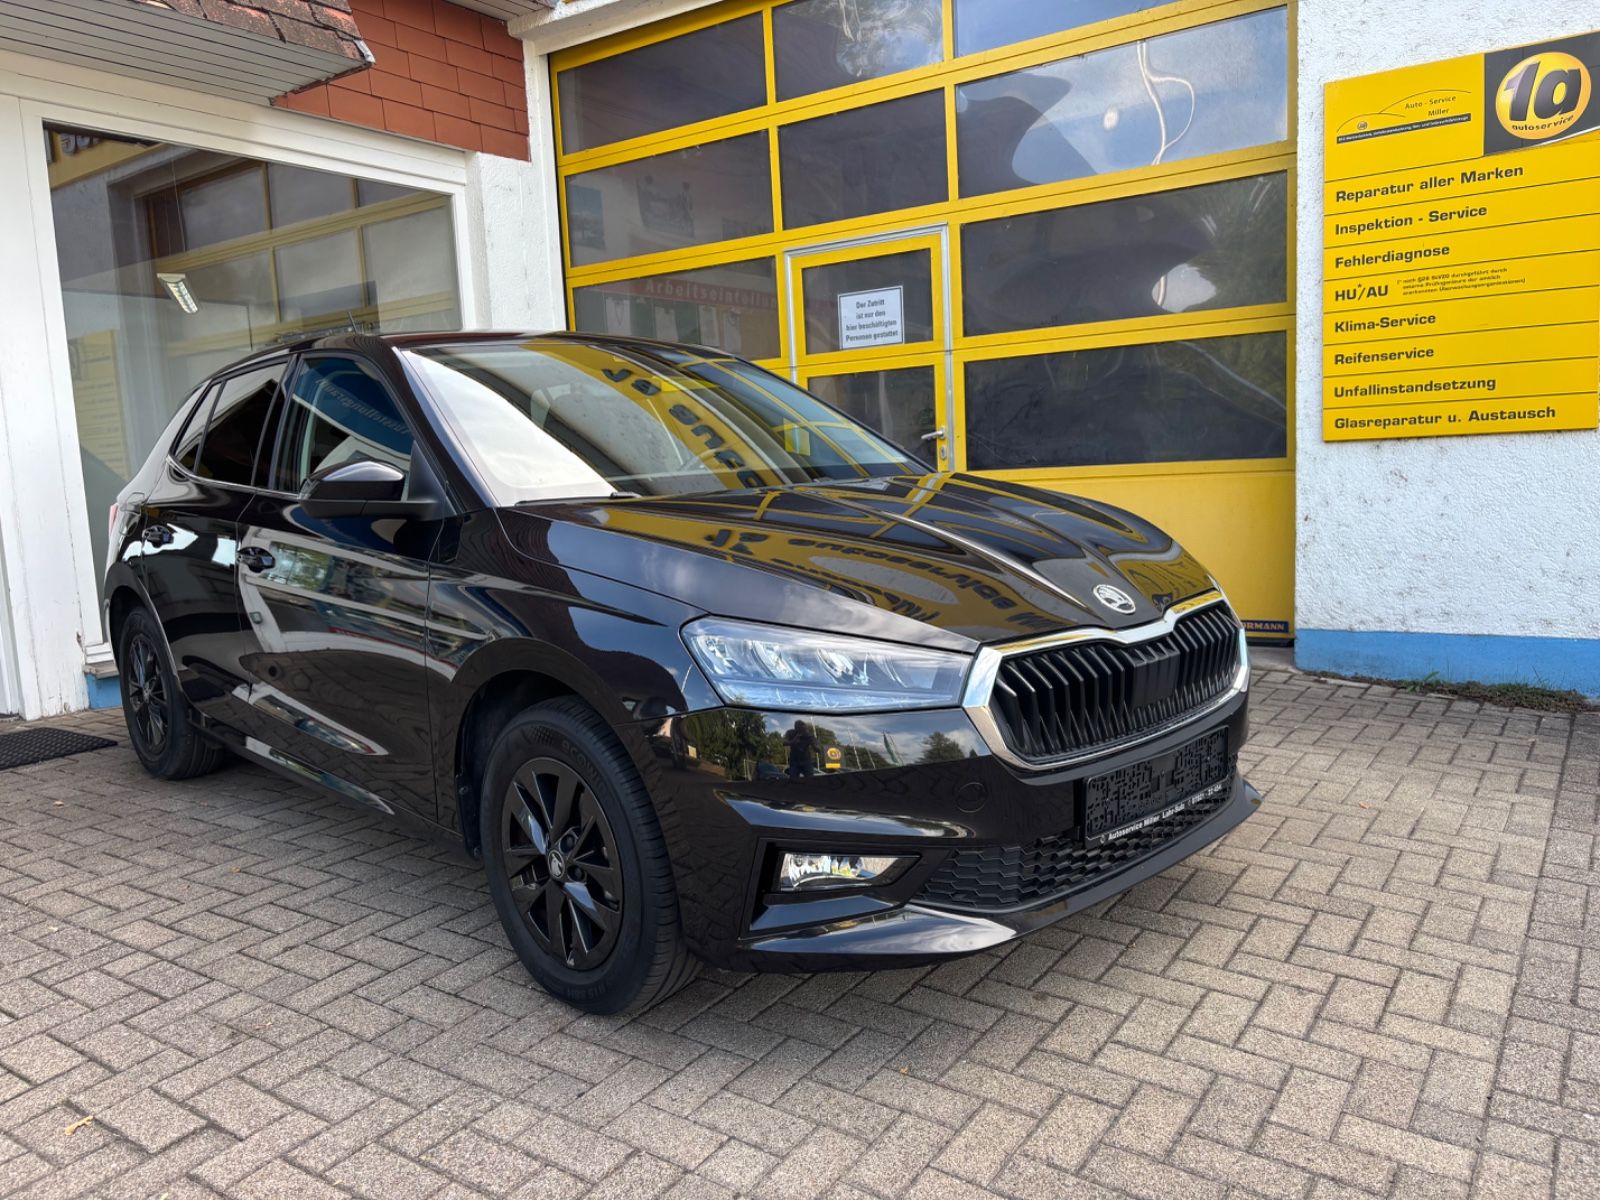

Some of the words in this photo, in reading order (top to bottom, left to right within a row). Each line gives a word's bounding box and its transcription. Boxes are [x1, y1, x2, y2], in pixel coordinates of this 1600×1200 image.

[1504, 61, 1582, 122] 1a
[1405, 101, 1423, 110] Auto
[1429, 95, 1457, 105] Service
[1428, 108, 1450, 117] Miller
[1511, 114, 1575, 132] autoservice
[1336, 182, 1414, 203] Reparatur
[1419, 176, 1455, 191] aller
[1460, 165, 1524, 184] Marken
[1335, 216, 1413, 236] Inspektion
[1428, 205, 1487, 223] Service
[1335, 245, 1450, 269] Fehlerdiagnose
[856, 301, 866, 309] Der
[867, 299, 885, 307] Zutritt
[1334, 314, 1436, 333] Klima-Service
[846, 333, 872, 341] Personen
[873, 330, 898, 340] gestattet
[1334, 347, 1434, 365] Reifenservice
[1334, 377, 1497, 398] Unfallinstandsetzung
[1334, 413, 1442, 430] Glasreparatur
[1448, 413, 1461, 424] u.
[1468, 406, 1556, 422] Austausch
[1242, 622, 1285, 630] RMANN
[1108, 822, 1143, 841] Autoservice
